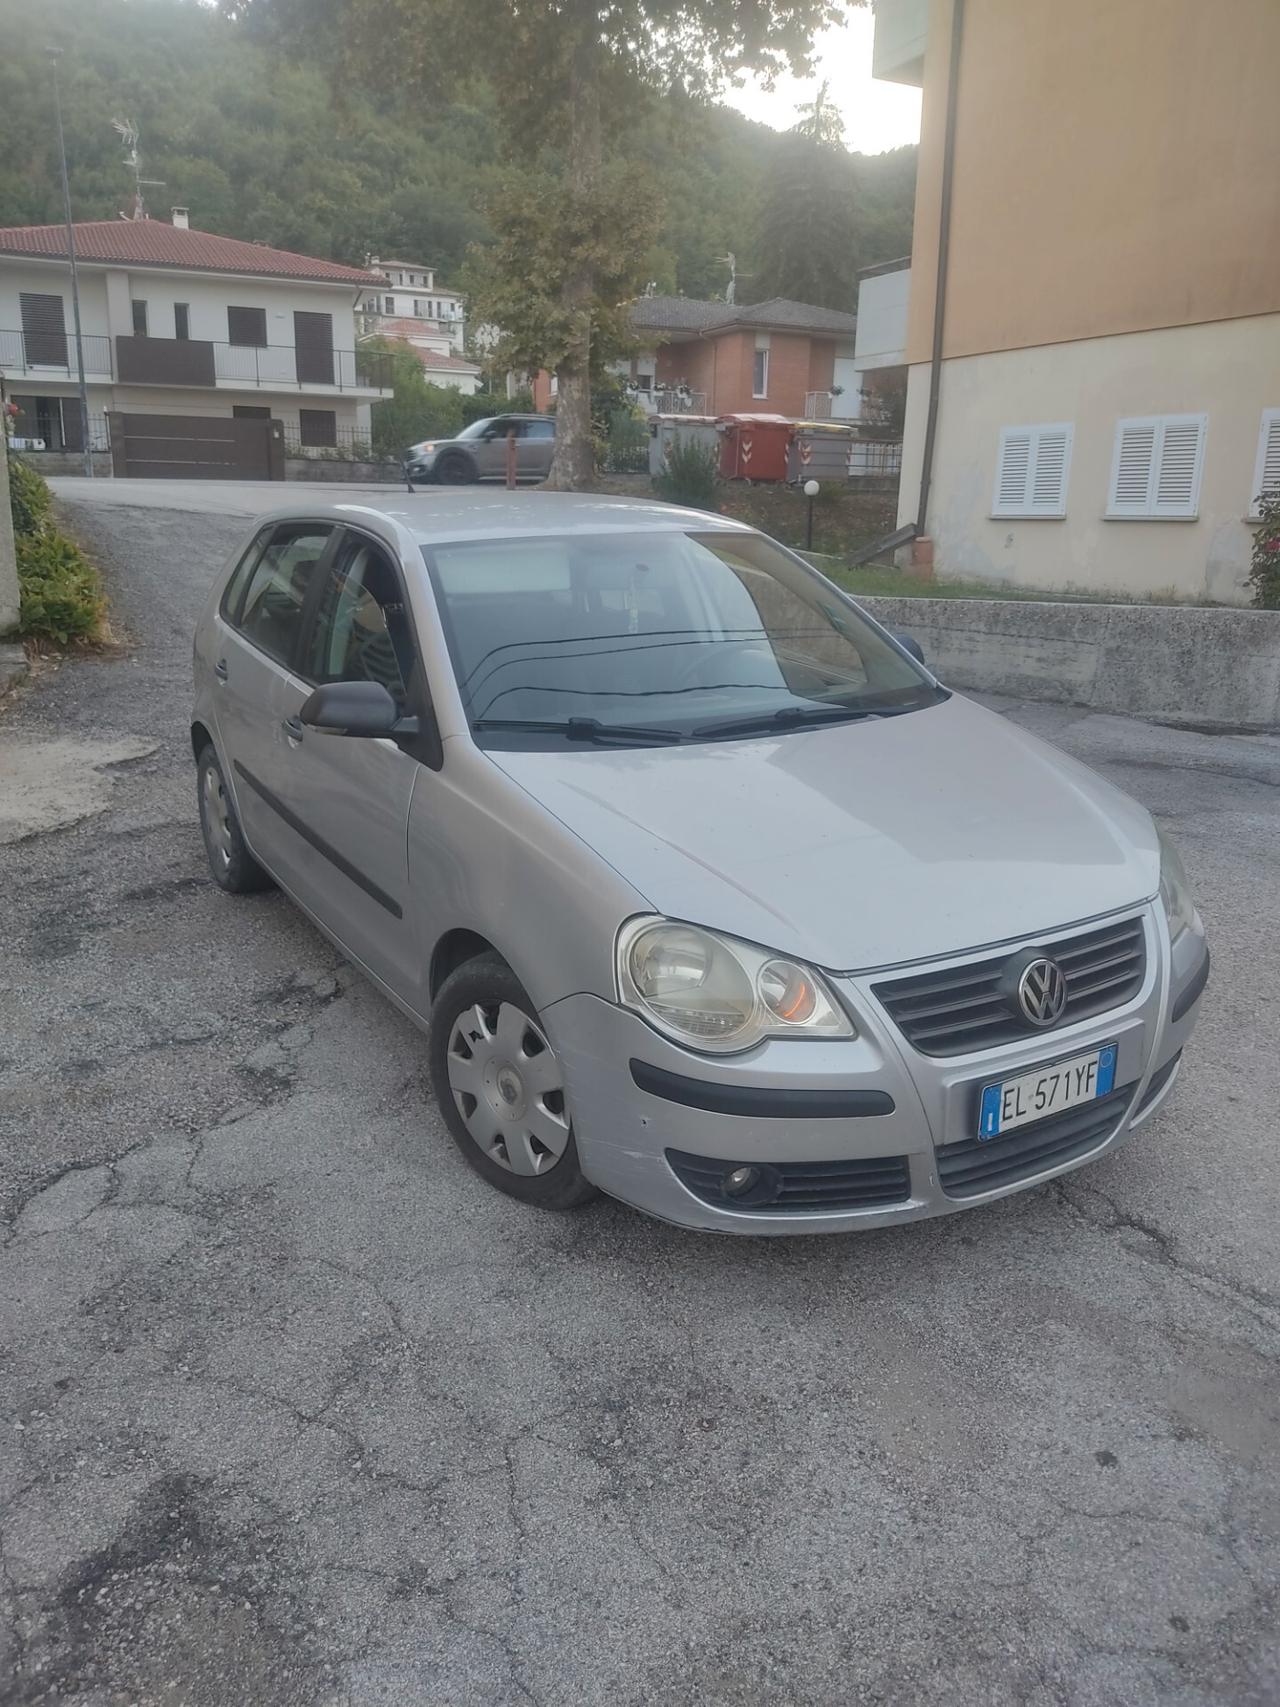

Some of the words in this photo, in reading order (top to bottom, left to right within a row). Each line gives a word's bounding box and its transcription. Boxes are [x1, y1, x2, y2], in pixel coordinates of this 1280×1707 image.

[1019, 959, 1065, 1025] VW
[1002, 1087, 1026, 1121] EL
[1035, 1060, 1097, 1110] 571YF
